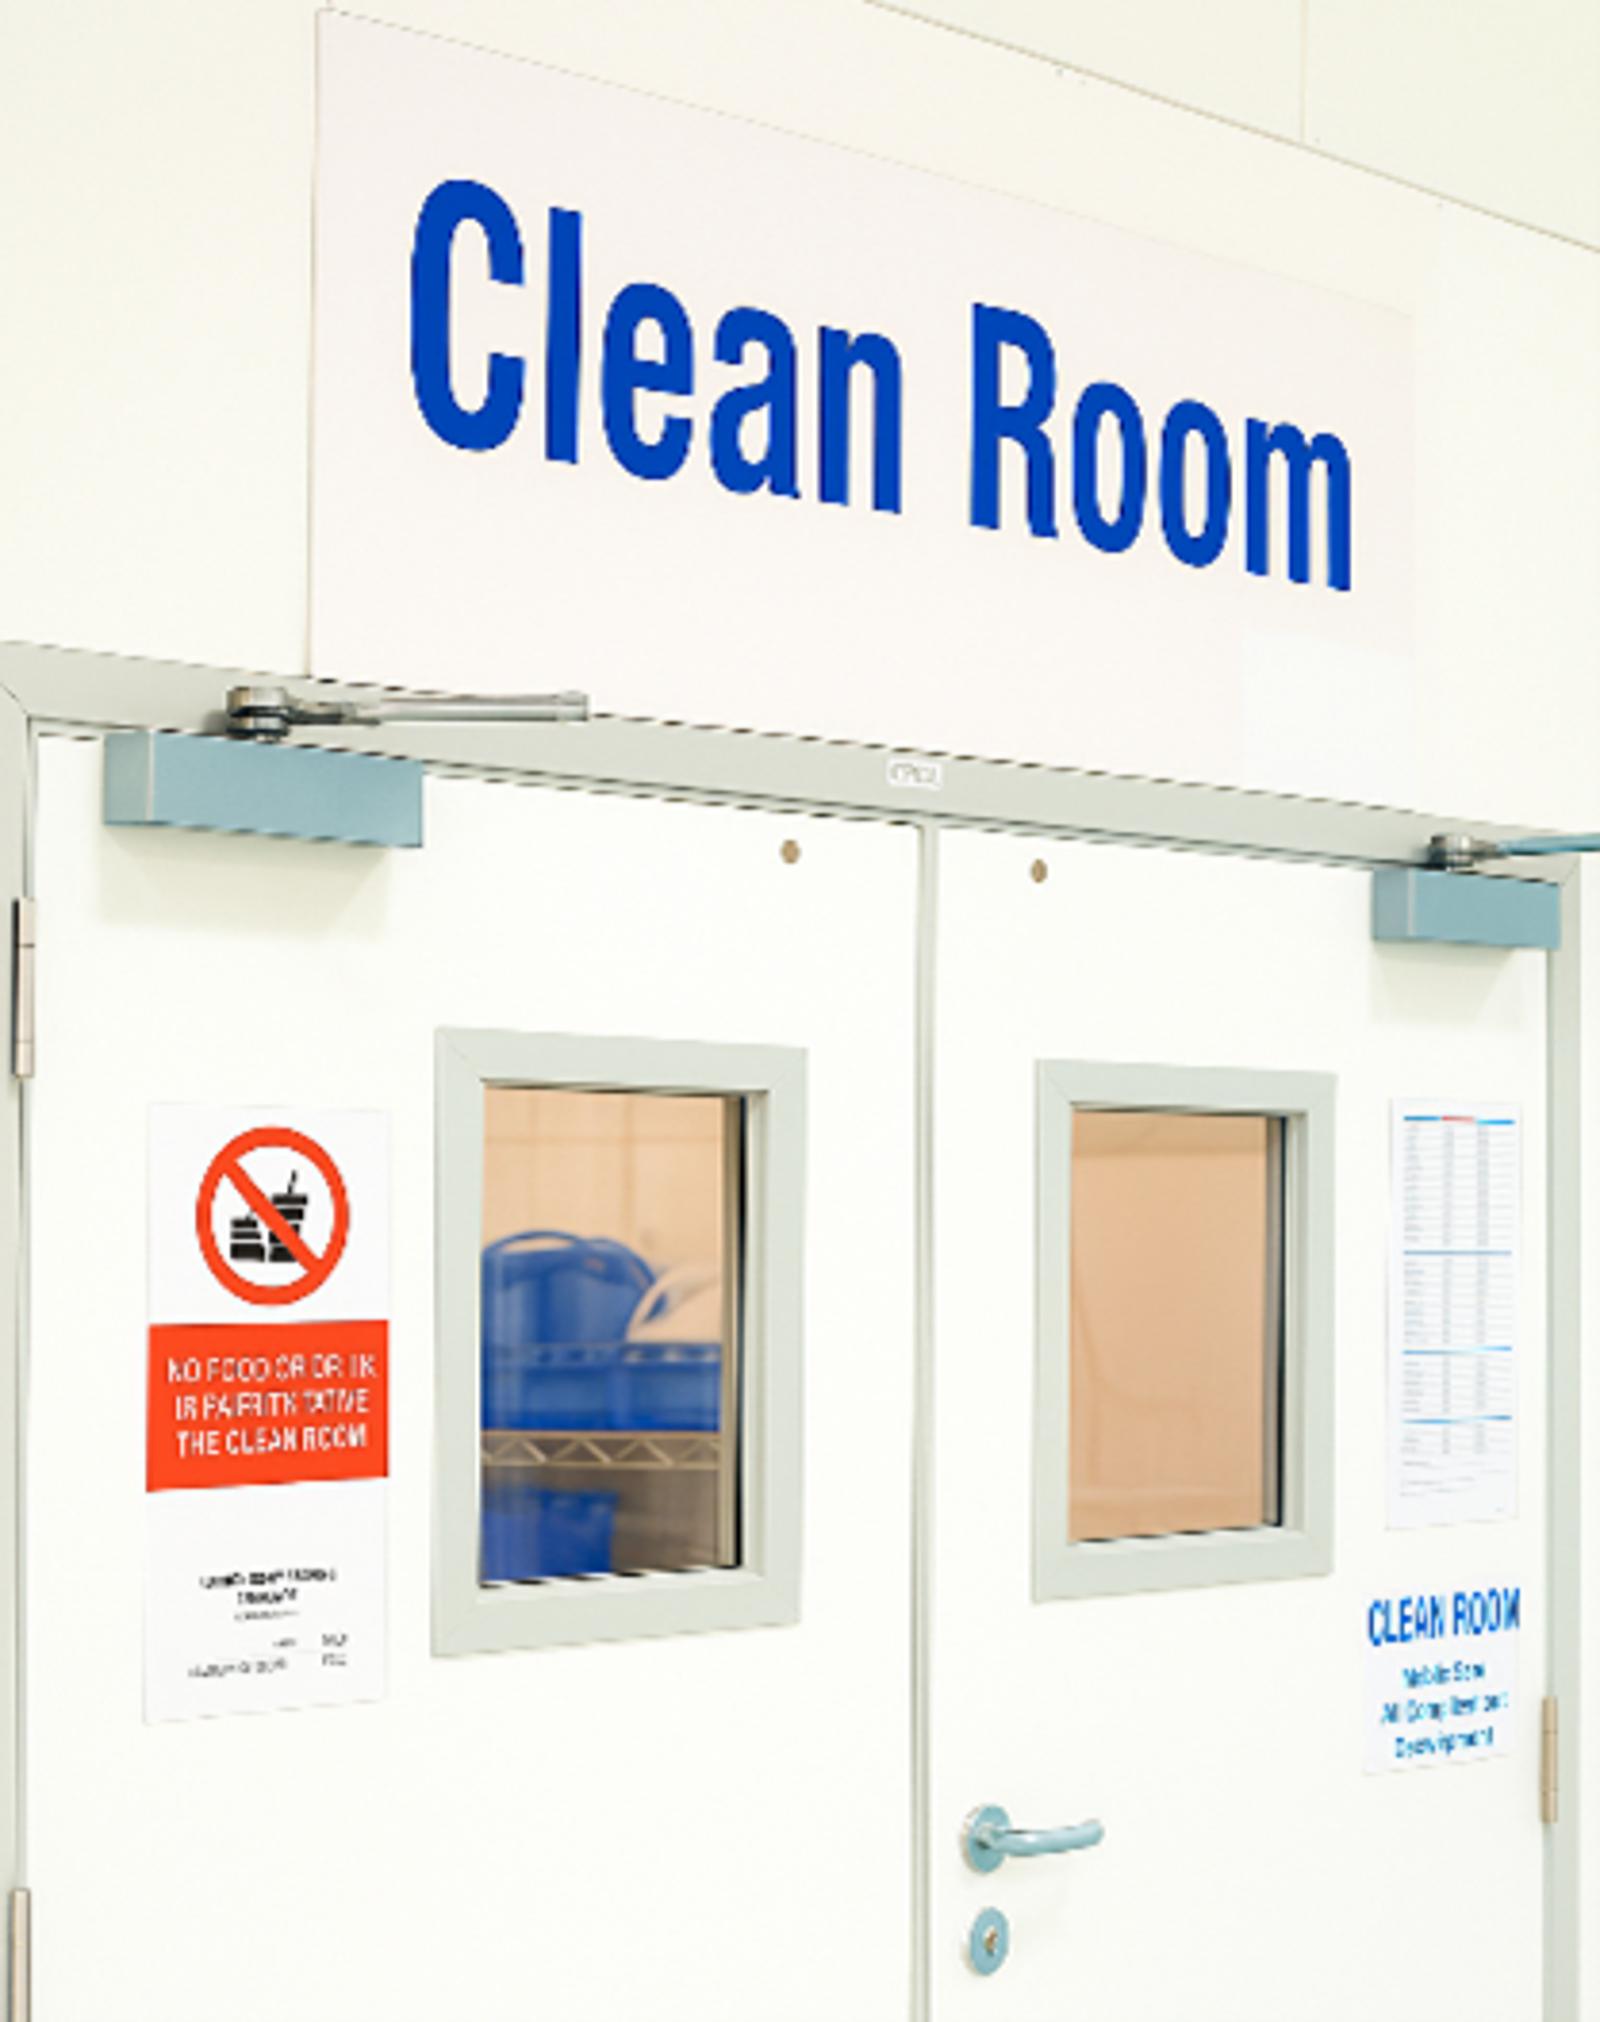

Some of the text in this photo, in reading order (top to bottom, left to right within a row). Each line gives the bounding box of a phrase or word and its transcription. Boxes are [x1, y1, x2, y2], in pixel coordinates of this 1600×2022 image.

[411, 180, 1352, 592] Clean Room
[167, 1357, 201, 1382] NO
[176, 1430, 221, 1458] THE
[226, 1425, 298, 1455] CLEAN
[1368, 1587, 1521, 1646] CLEAN ROOM
